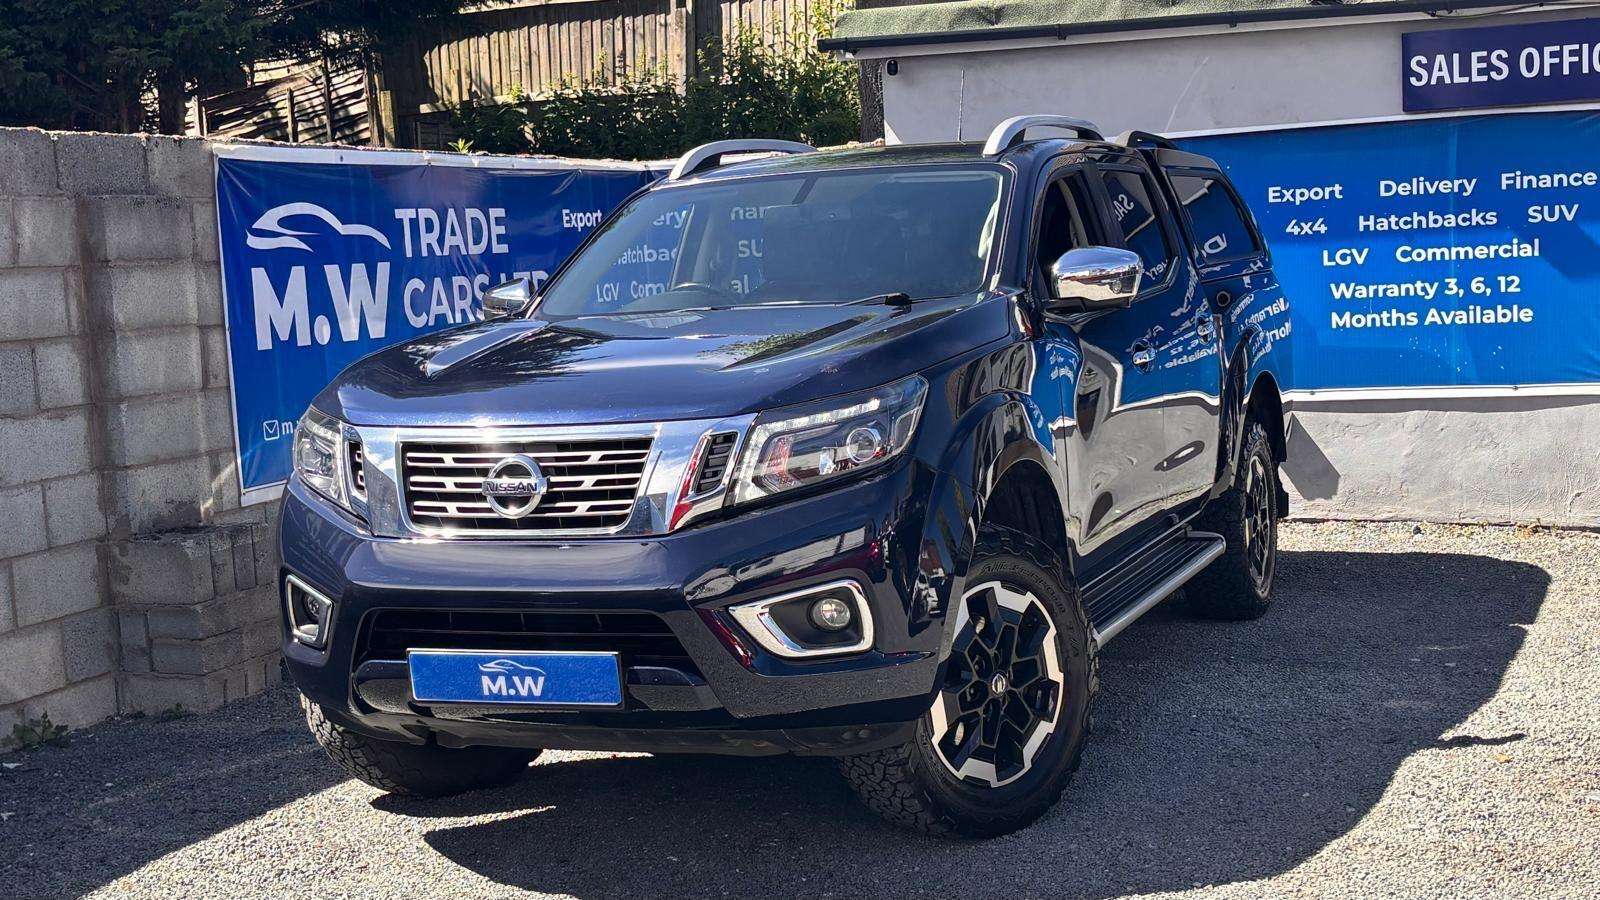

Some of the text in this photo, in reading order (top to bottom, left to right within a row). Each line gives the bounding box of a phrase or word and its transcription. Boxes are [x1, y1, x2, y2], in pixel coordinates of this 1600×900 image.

[1409, 49, 1509, 86] SALES
[1268, 171, 1598, 205] Export Delivery Finance
[395, 208, 508, 257] TRADE
[562, 209, 603, 233] Export
[1286, 204, 1579, 235] 4x4 Hatchbacks SUV
[1322, 239, 1540, 266] LGV Commercial
[403, 274, 490, 329] CARS
[596, 282, 619, 303] LGV
[1330, 275, 1521, 304] Warranty 3, 6, 12
[251, 262, 390, 350] M.W
[1331, 305, 1534, 329] Months Available
[486, 481, 537, 492] NISSAN
[481, 675, 545, 697] M.W
